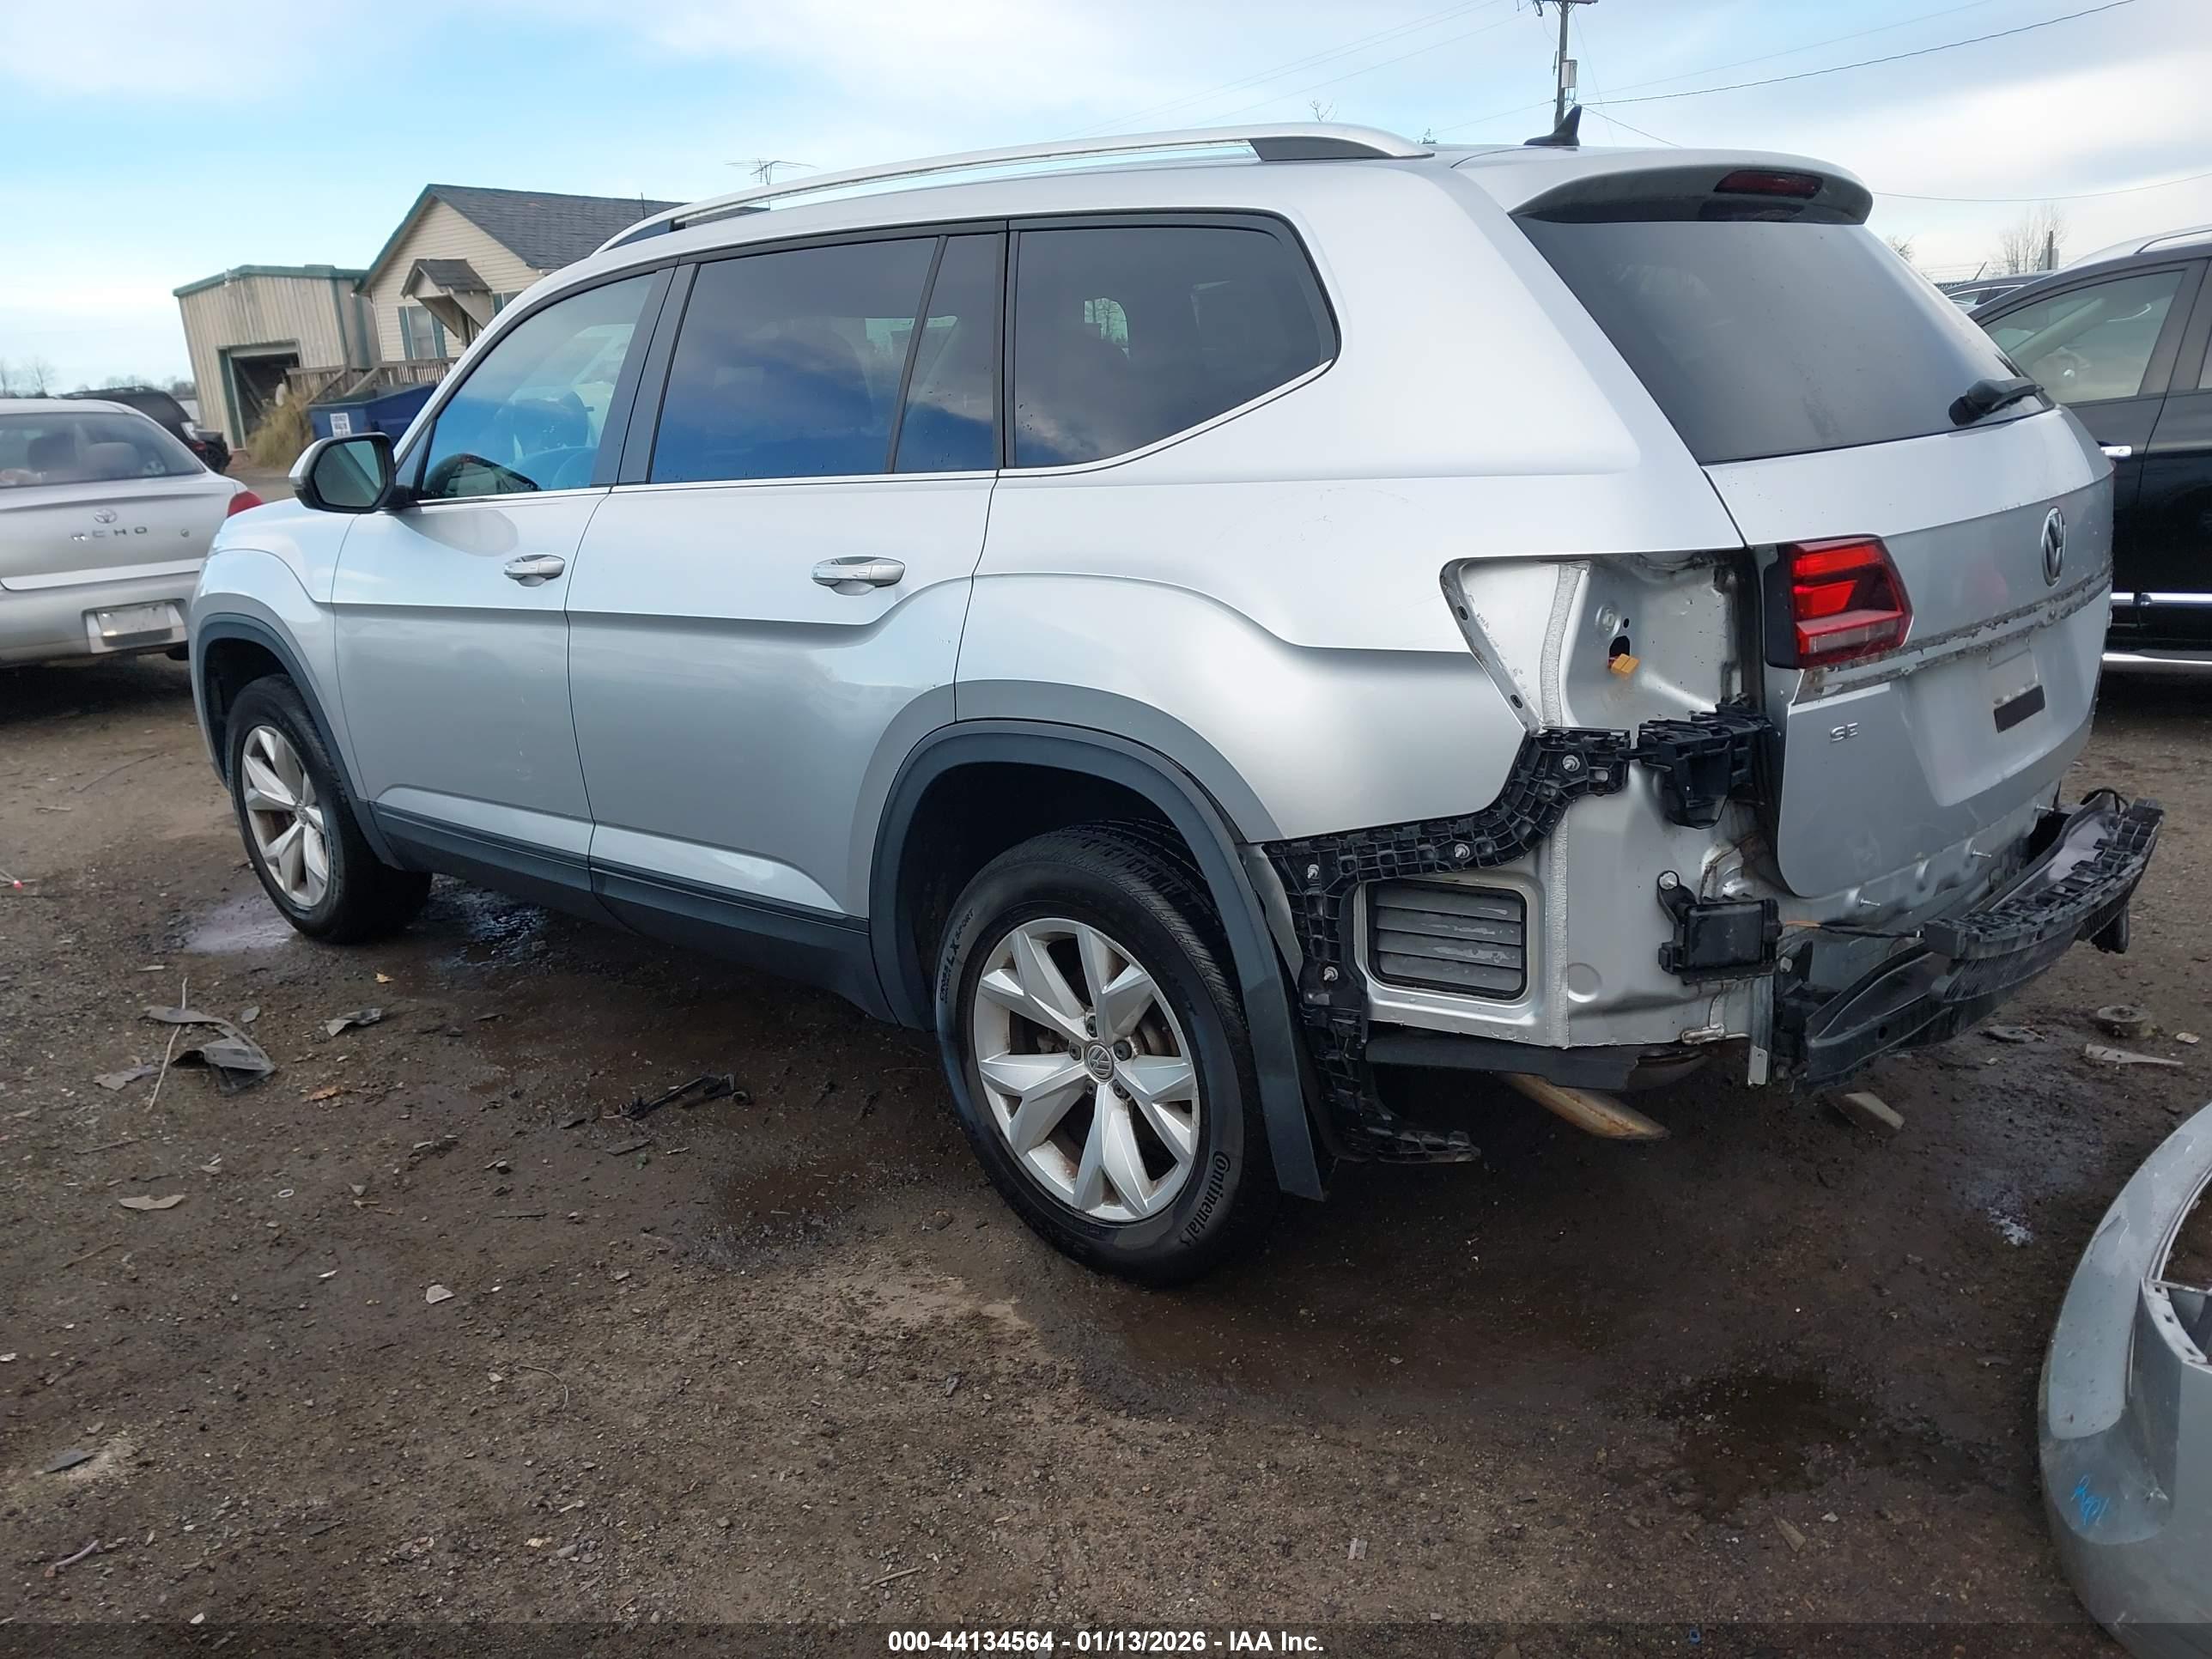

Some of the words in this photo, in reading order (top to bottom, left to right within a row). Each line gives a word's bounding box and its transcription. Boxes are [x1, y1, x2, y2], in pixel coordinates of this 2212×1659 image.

[1830, 722, 1859, 743] SE
[955, 908, 974, 940] SPORT
[1185, 1151, 1231, 1242] Continental
